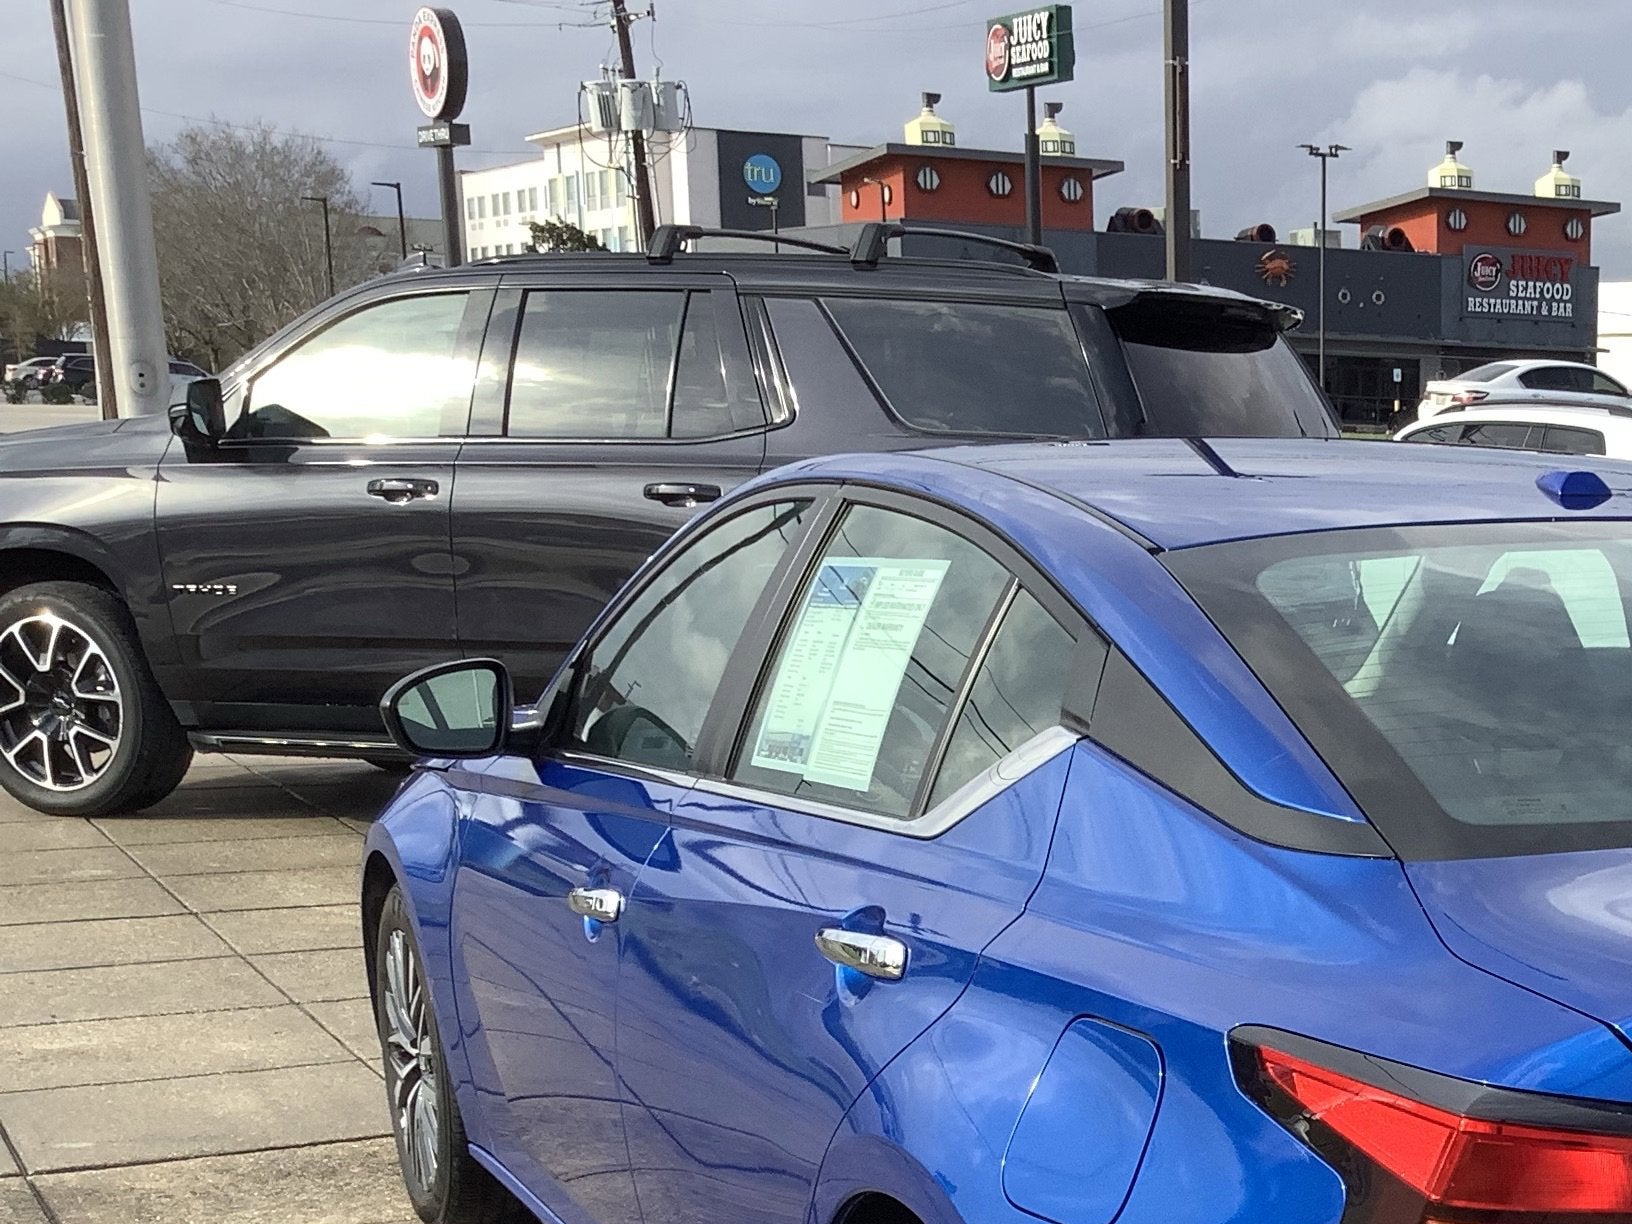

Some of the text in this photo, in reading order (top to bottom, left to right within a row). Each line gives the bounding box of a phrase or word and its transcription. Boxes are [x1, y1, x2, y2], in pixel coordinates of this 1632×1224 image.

[1010, 11, 1050, 46] JUICY
[1010, 40, 1050, 65] SEAFOOD
[744, 162, 774, 183] tru
[1506, 254, 1573, 283] JUICY
[1509, 280, 1572, 300] SEAFOOD
[1467, 297, 1573, 317] RESTAURANT & BAR
